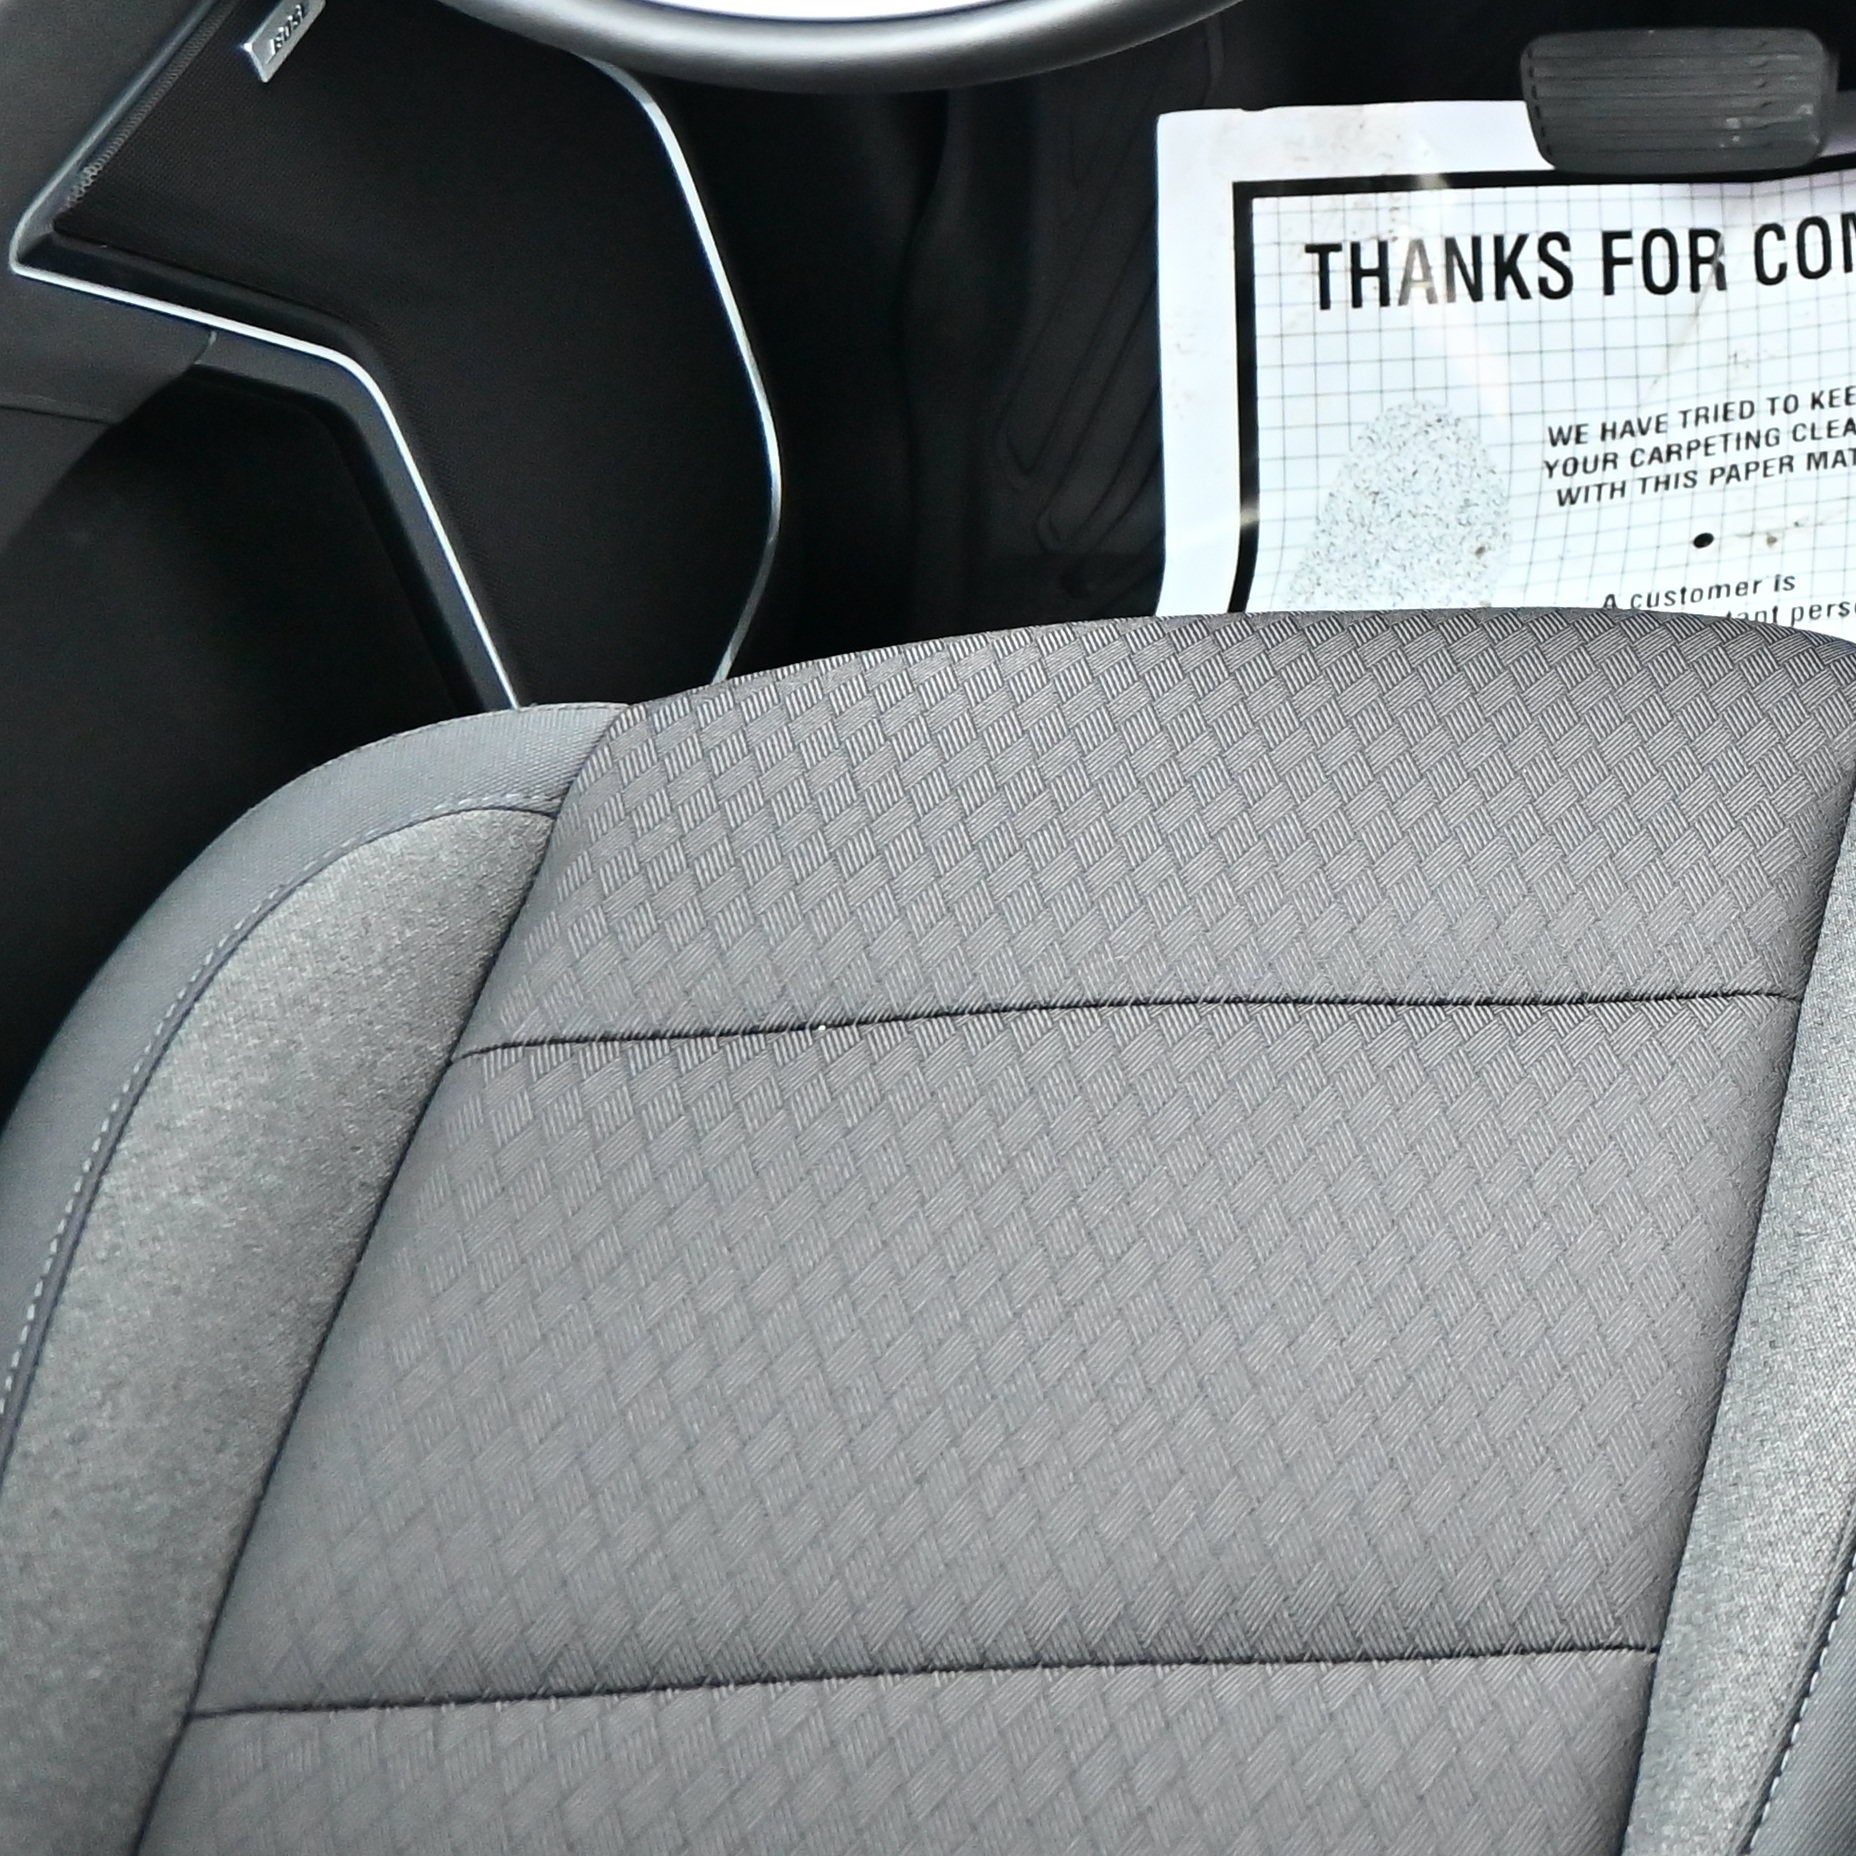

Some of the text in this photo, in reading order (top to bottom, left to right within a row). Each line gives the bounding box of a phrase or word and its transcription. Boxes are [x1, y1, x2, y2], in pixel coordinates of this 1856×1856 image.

[1304, 230, 1575, 312] THANKS
[1602, 227, 1728, 298] FOR
[1548, 423, 1590, 447] WE
[1601, 413, 1669, 443] HAVE
[1679, 400, 1756, 429] TRIED
[1766, 394, 1799, 416] TO
[1544, 451, 1619, 479] YOUR
[1629, 427, 1781, 468] CARPETING
[1557, 480, 1627, 507] WITH
[1641, 469, 1698, 495] THIS
[1709, 455, 1795, 486] PAPER
[1602, 573, 1796, 610] A customer is
